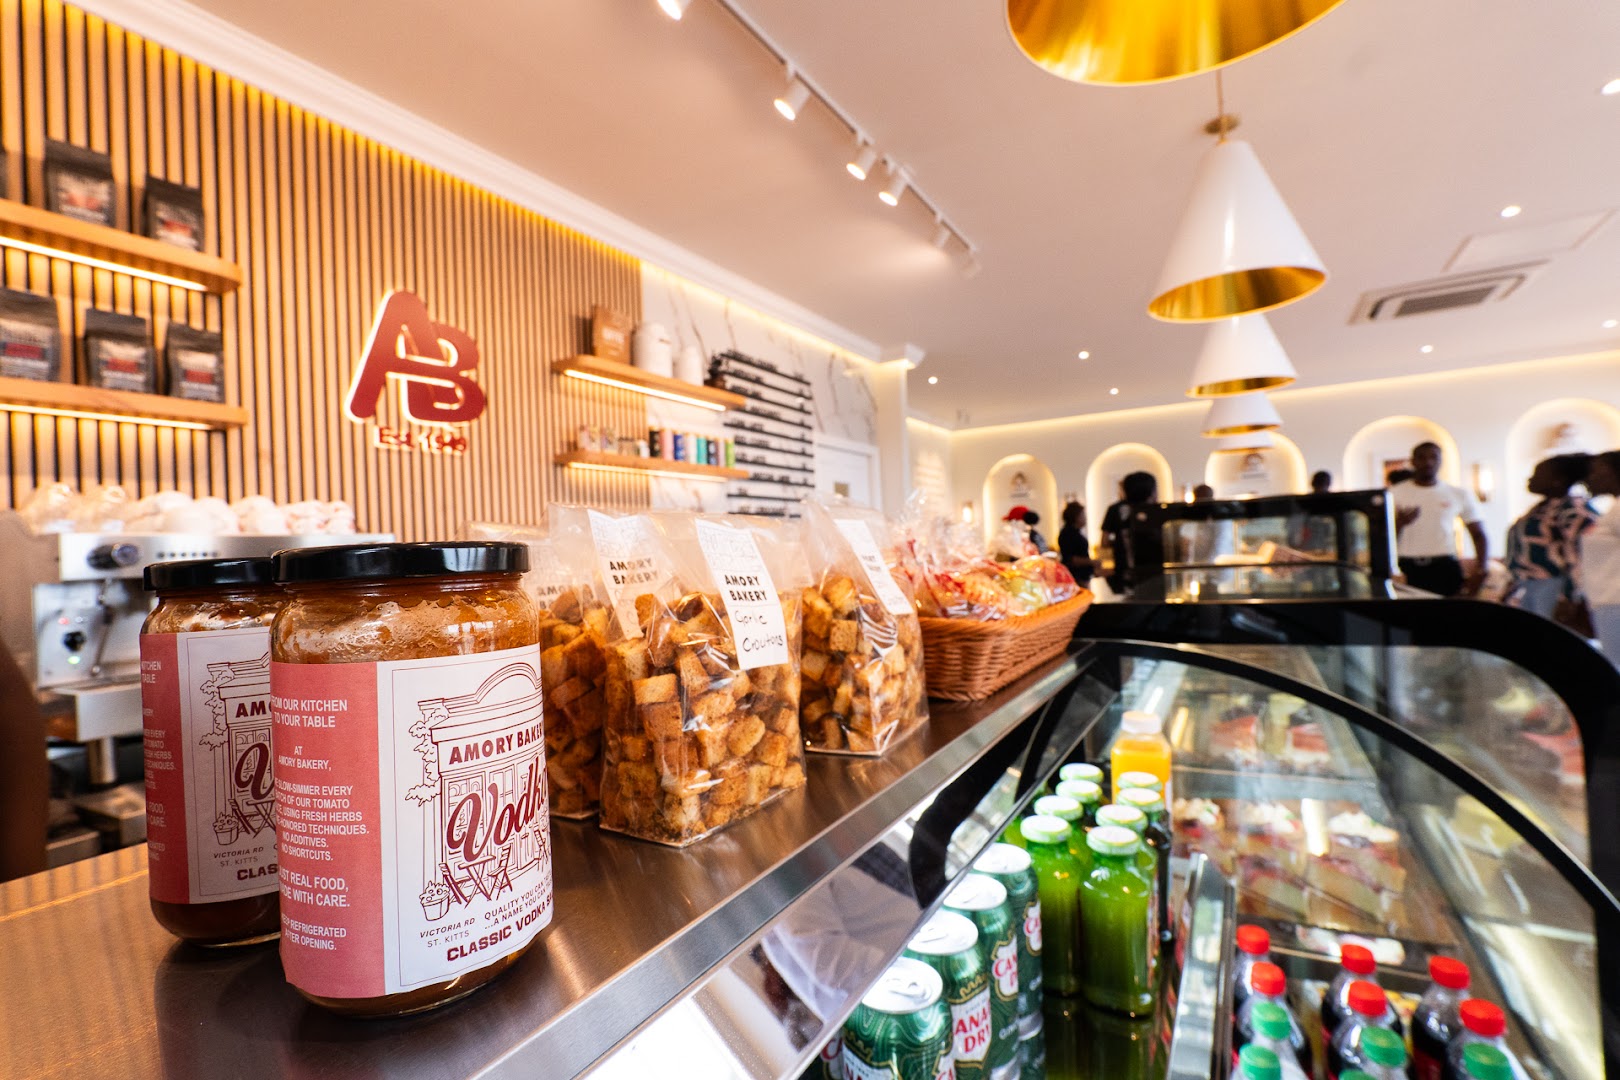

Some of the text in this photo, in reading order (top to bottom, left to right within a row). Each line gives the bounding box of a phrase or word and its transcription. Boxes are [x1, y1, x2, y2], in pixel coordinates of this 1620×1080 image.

[609, 557, 653, 571] AMORY
[724, 574, 760, 587] AMORY
[729, 590, 767, 602] BAKERY
[283, 698, 299, 711] OUR
[300, 699, 348, 712] KITCHEN
[274, 712, 336, 728] TO YOUR TABLE
[294, 745, 303, 756] AT
[448, 733, 514, 766] AMORY
[278, 755, 332, 772] AMORY BAKERY,
[321, 785, 353, 796] EVERY
[287, 795, 295, 805] OF
[295, 796, 311, 808] OUR
[312, 798, 350, 809] TOMATO
[283, 806, 300, 819] USING
[301, 810, 327, 822] FRESH
[329, 811, 363, 822] HERBS
[308, 823, 370, 836] TECHNIQUES.
[282, 831, 329, 848] NO ADDITIVES.
[213, 846, 264, 859] VICTORIA RD
[234, 855, 259, 865] KITTS
[281, 843, 333, 861] NO SHORTCUTS.
[236, 863, 278, 881] CLAS
[290, 872, 312, 889] REAL
[314, 876, 349, 892] FOOD,
[292, 889, 314, 905] WITH
[315, 893, 350, 907] CARE.
[484, 897, 520, 920] QUALITY
[520, 889, 534, 902] YOU
[420, 921, 462, 939] VICTORIA
[464, 917, 476, 926] RD
[501, 904, 524, 921] NAME
[524, 895, 537, 908] YOU
[290, 919, 347, 938] REFRIGERATED
[446, 902, 546, 962] CLASSIC VODKA
[300, 935, 337, 951] OPENING.
[427, 930, 470, 948] ST. KITTS
